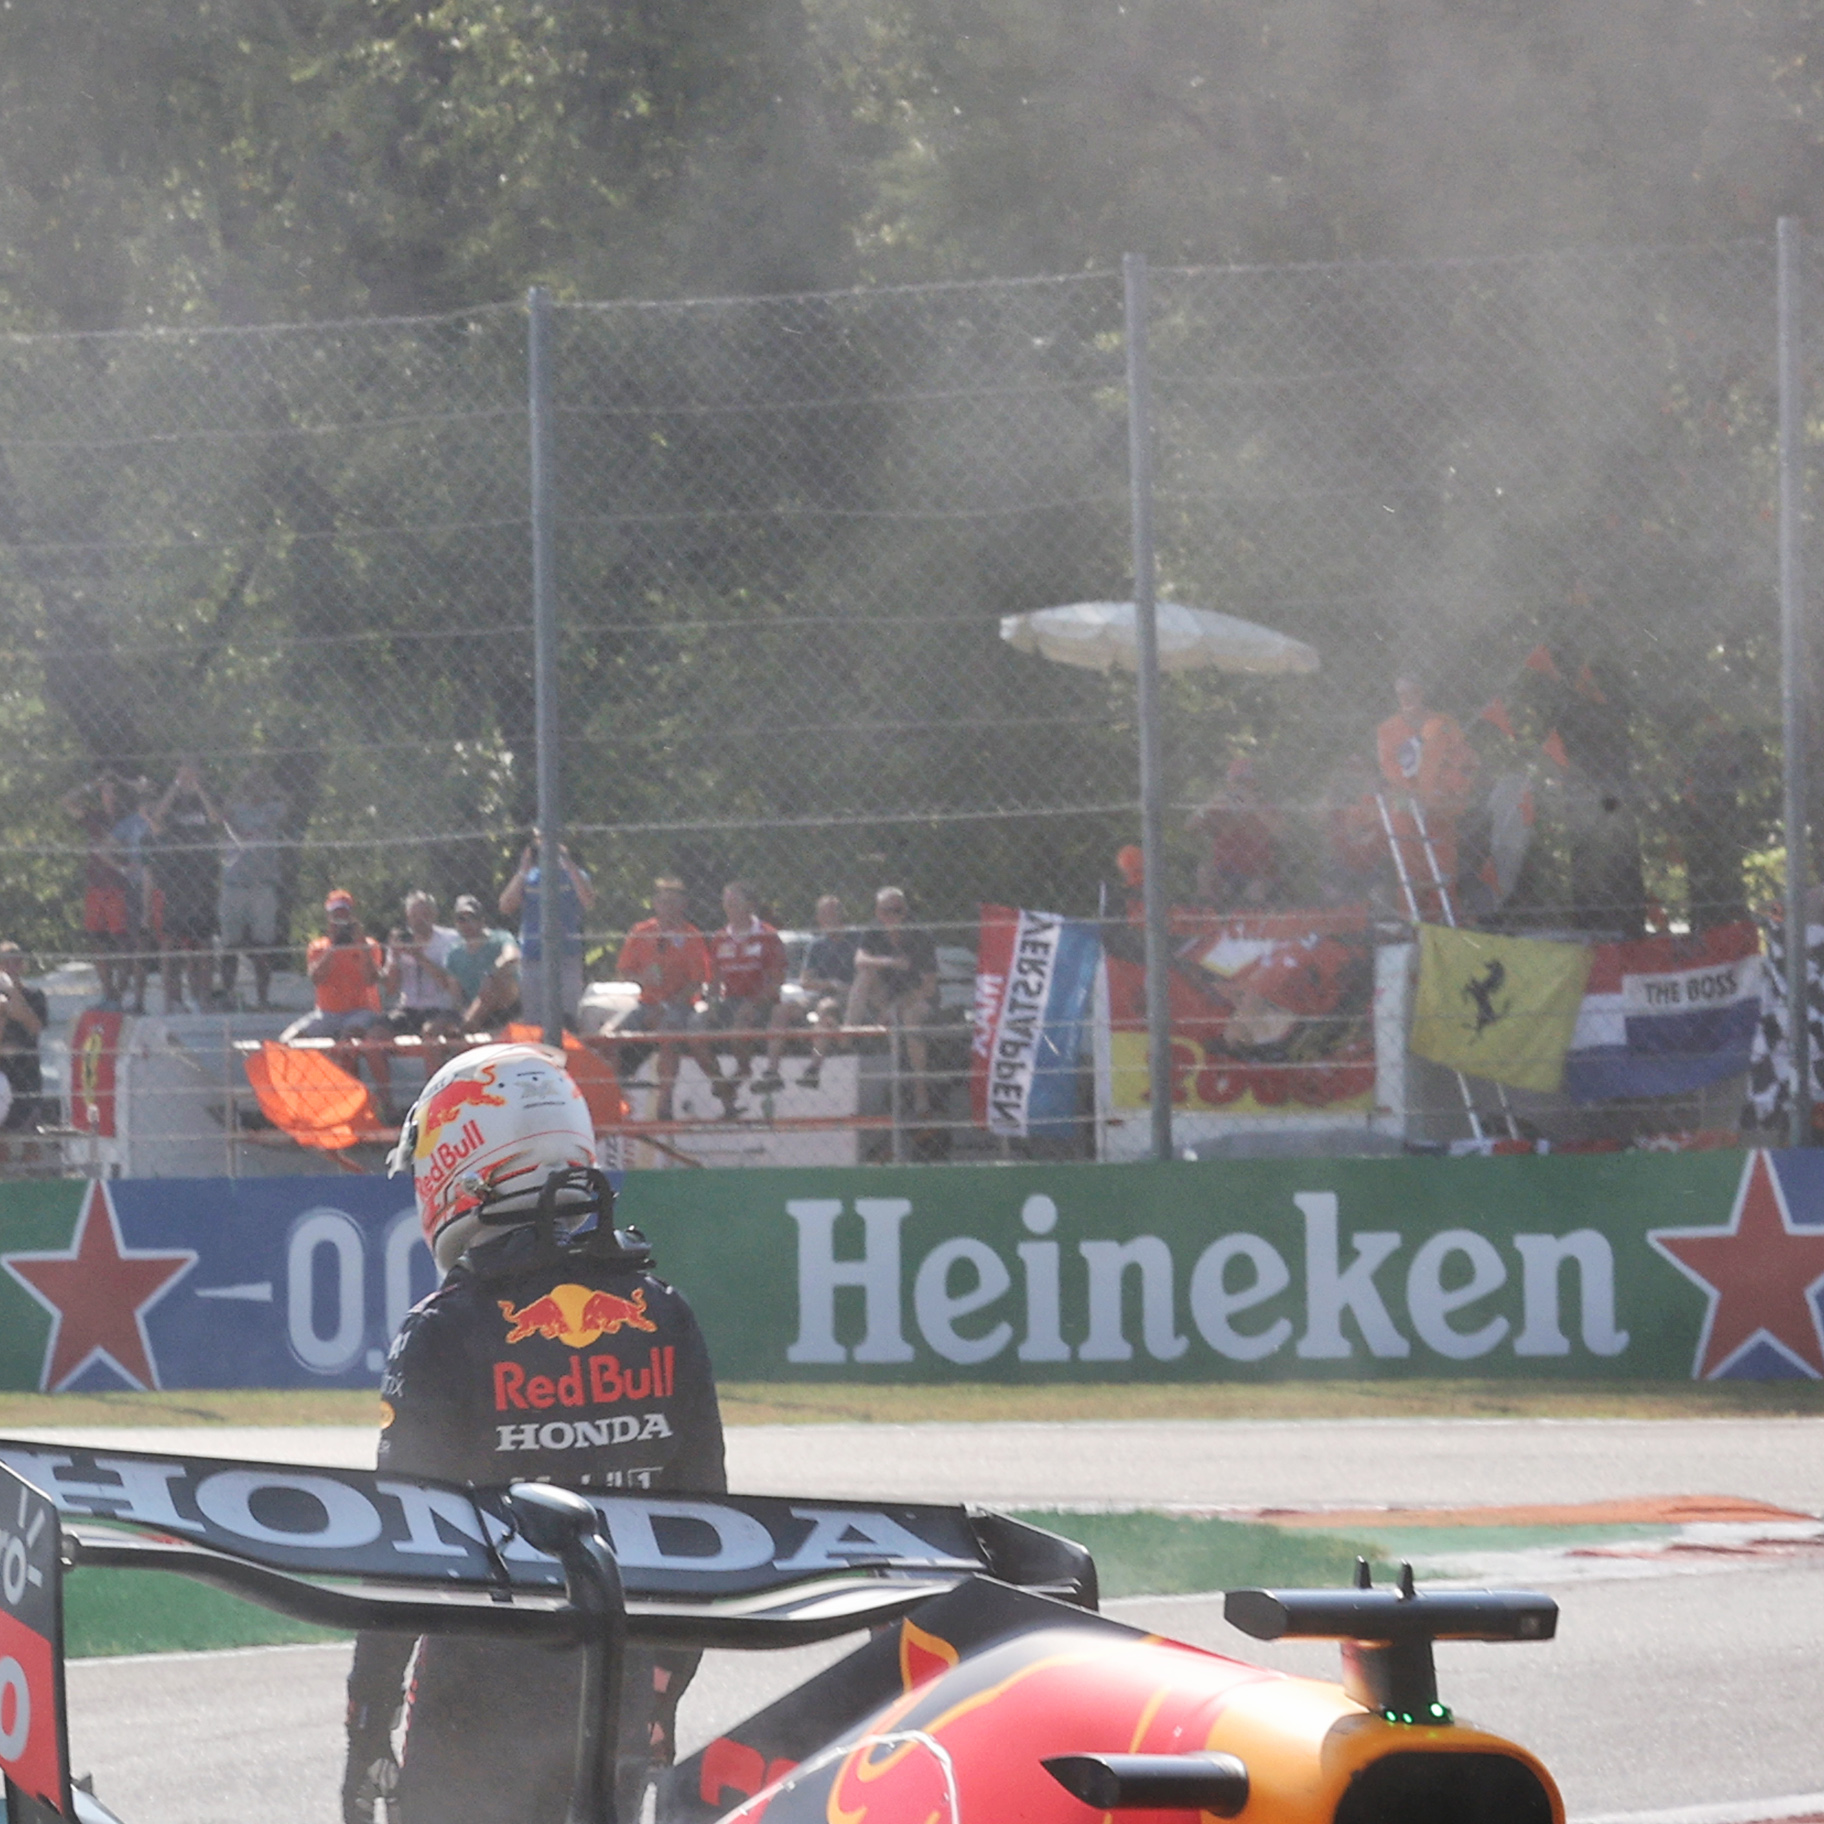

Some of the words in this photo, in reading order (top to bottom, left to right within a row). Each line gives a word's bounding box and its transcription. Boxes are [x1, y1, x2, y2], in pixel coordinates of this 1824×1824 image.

[1644, 981, 1679, 1004] THE
[1687, 971, 1738, 1001] BOSS
[414, 1153, 445, 1198] Red
[437, 1120, 486, 1170] Bull
[785, 1191, 1630, 1364] Heineken
[493, 1355, 585, 1411] Red
[589, 1346, 675, 1401] Bull
[495, 1413, 673, 1452] HONDA
